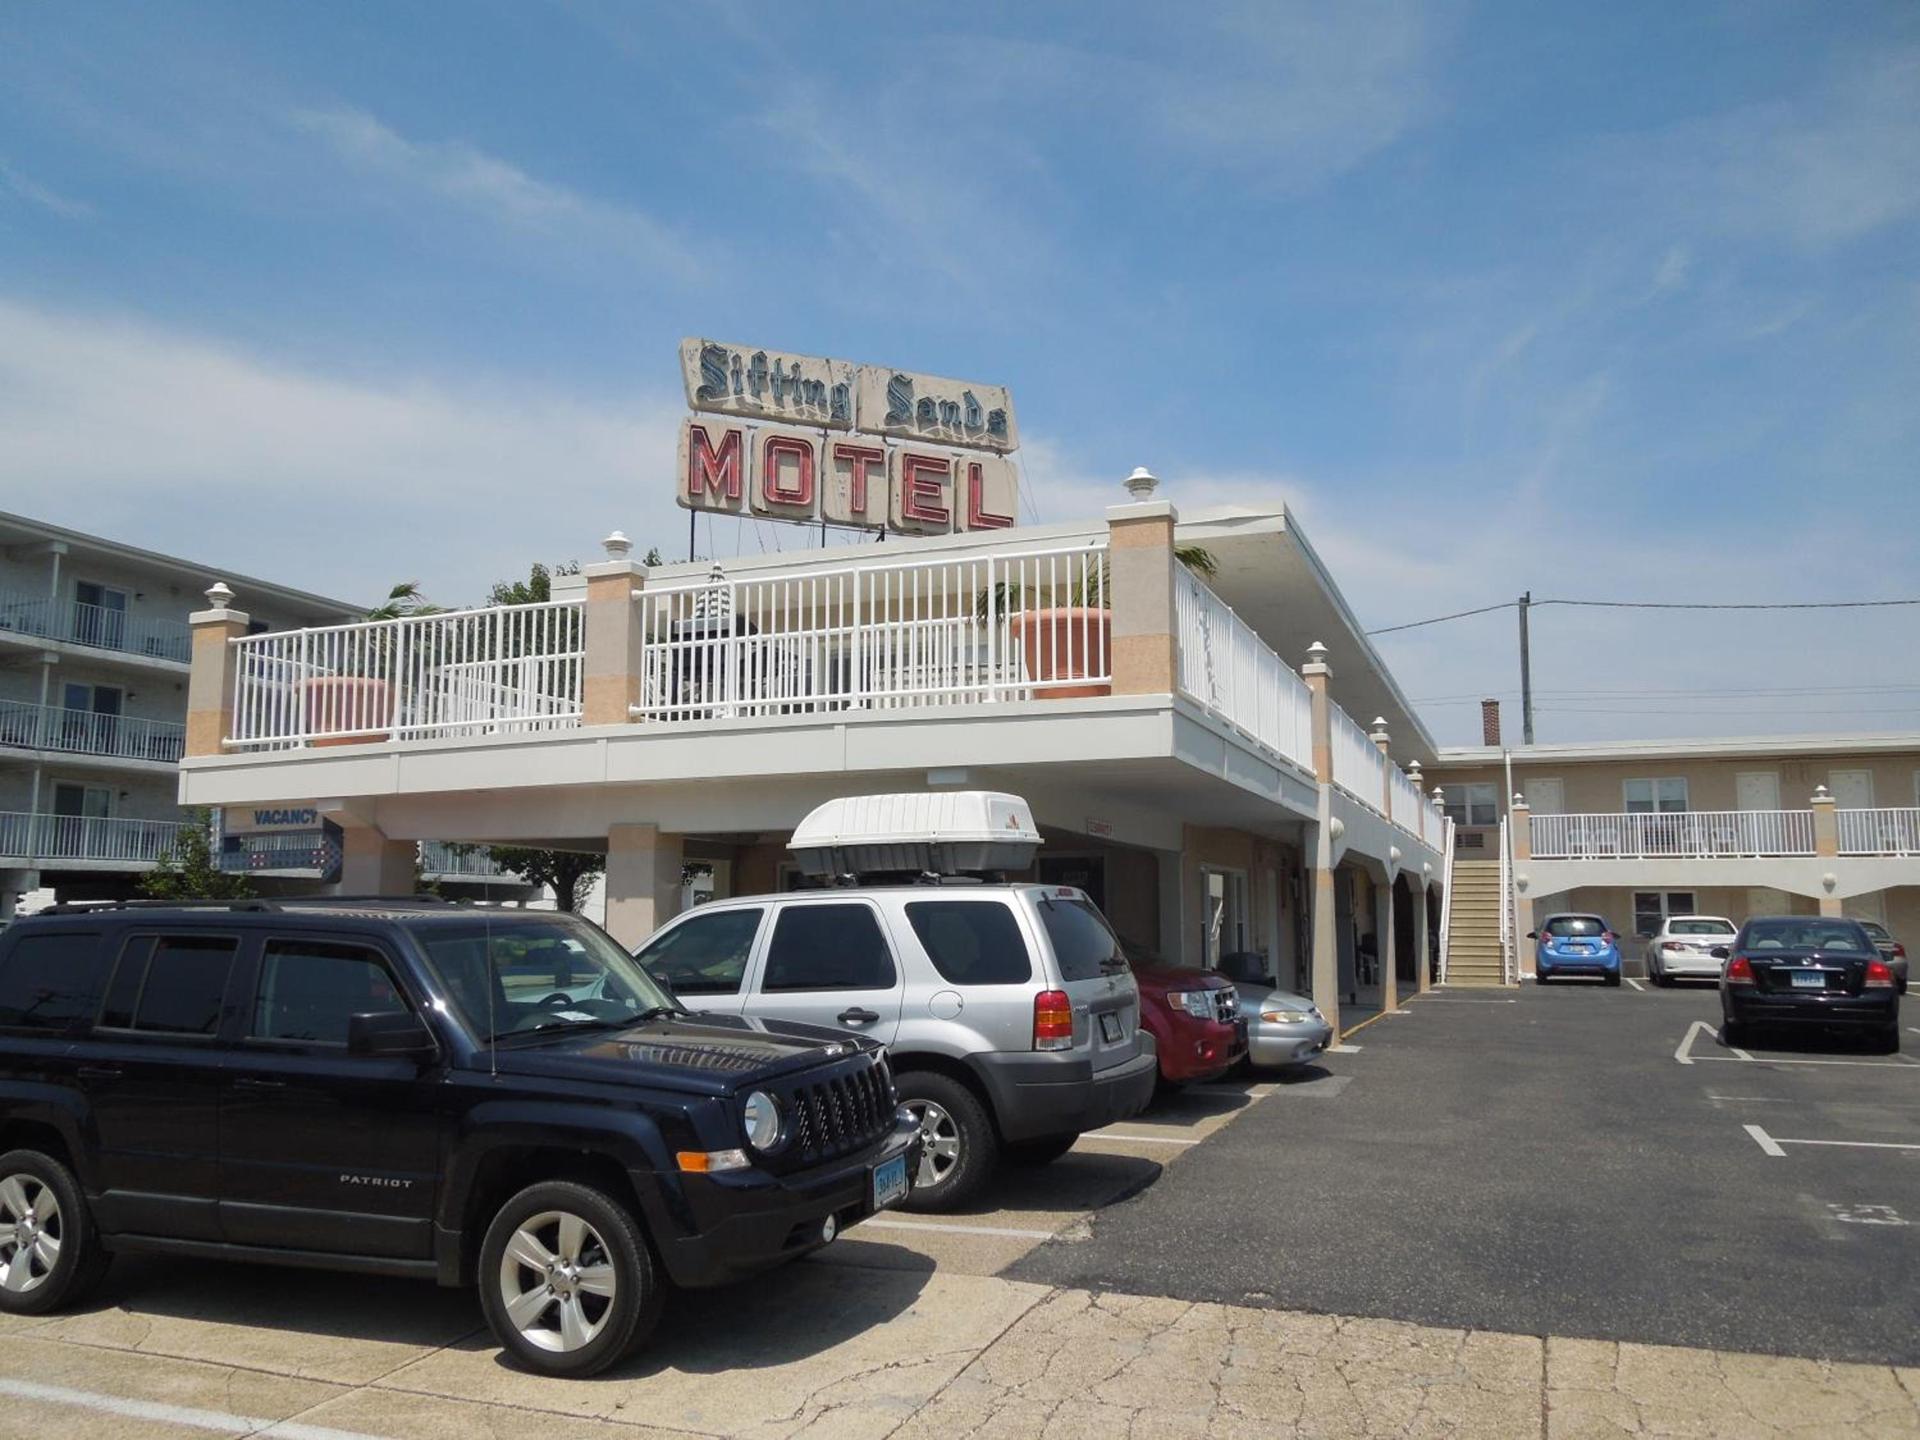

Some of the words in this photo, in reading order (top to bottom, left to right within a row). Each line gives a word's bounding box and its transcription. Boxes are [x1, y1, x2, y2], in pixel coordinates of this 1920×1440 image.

[696, 343, 852, 421] Sifting
[688, 424, 1014, 529] MOTEL
[254, 808, 318, 825] VACANCY
[339, 1174, 412, 1188] PATRIOT
